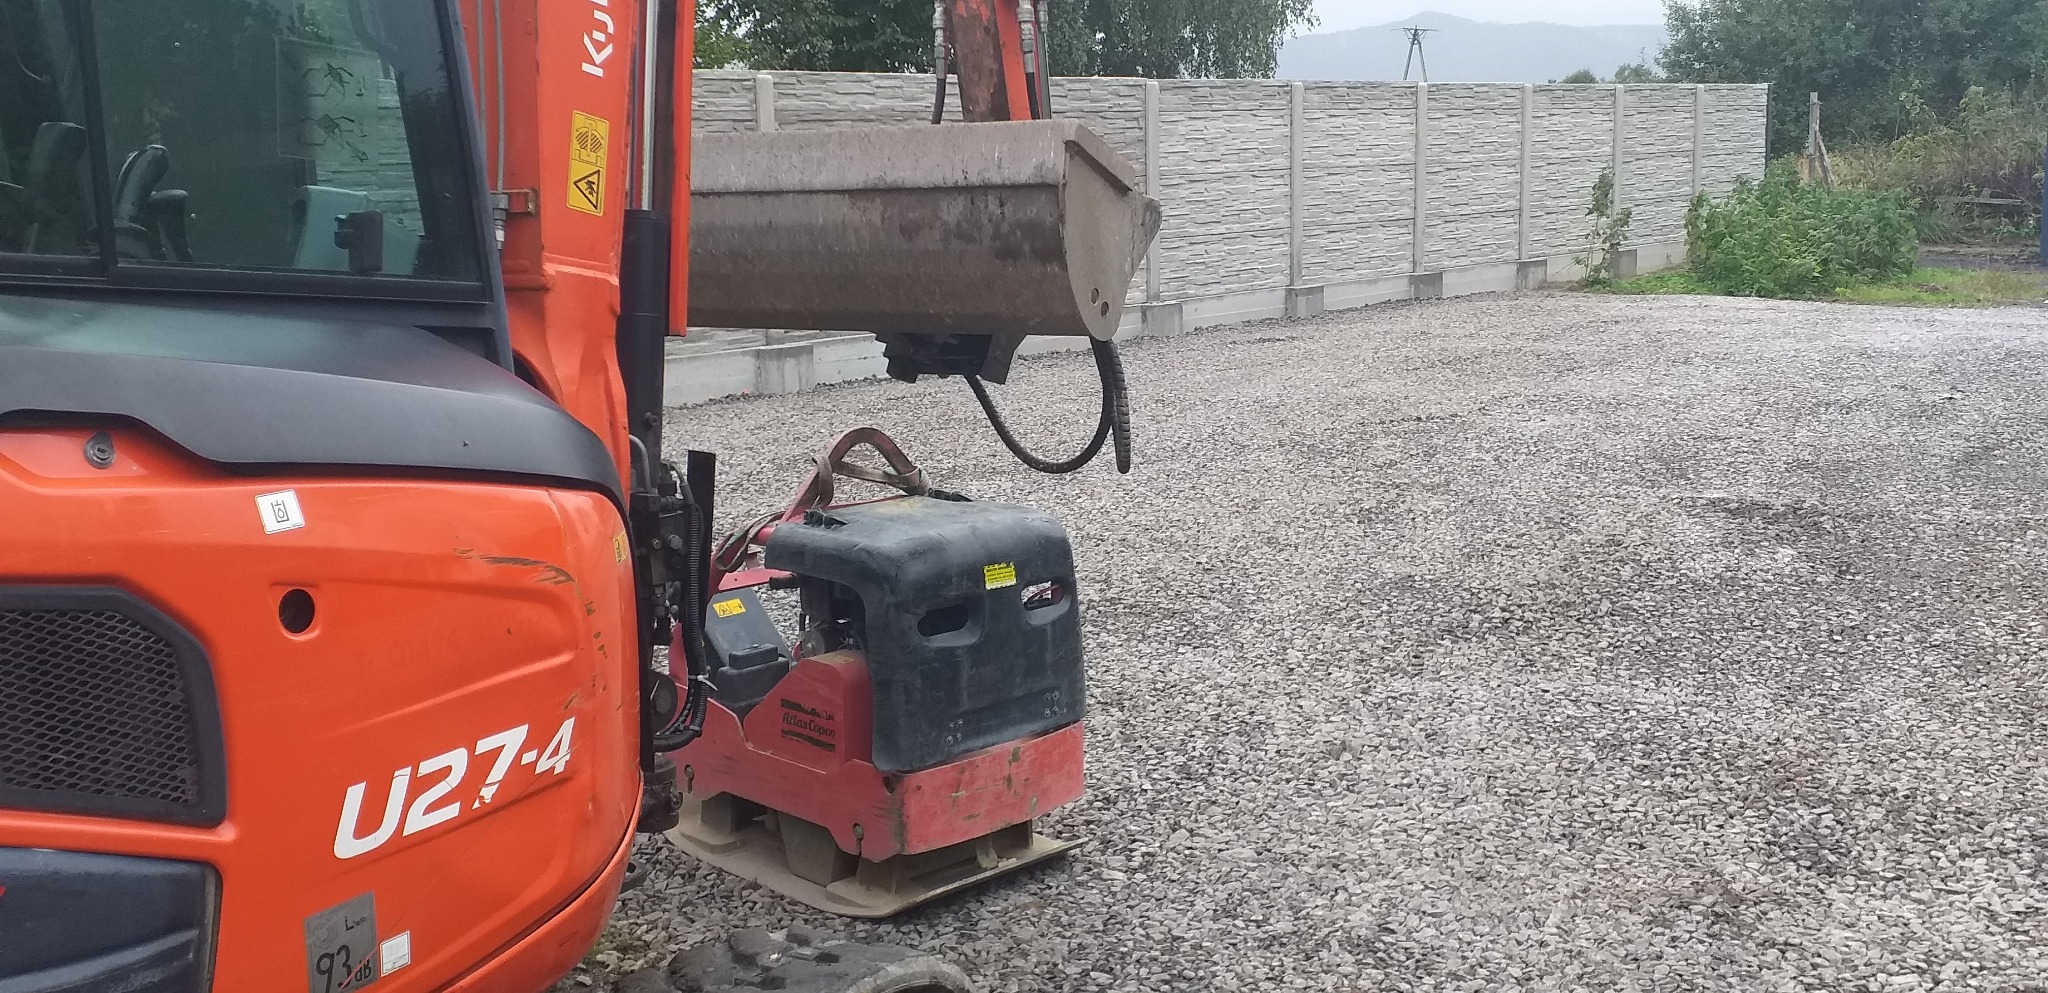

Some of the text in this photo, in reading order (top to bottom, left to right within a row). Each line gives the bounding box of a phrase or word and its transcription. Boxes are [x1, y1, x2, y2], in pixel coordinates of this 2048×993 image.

[582, 0, 614, 77] Ku
[782, 712, 836, 738] Atlas Copco
[333, 716, 576, 860] U27-4
[316, 944, 353, 993] 93
